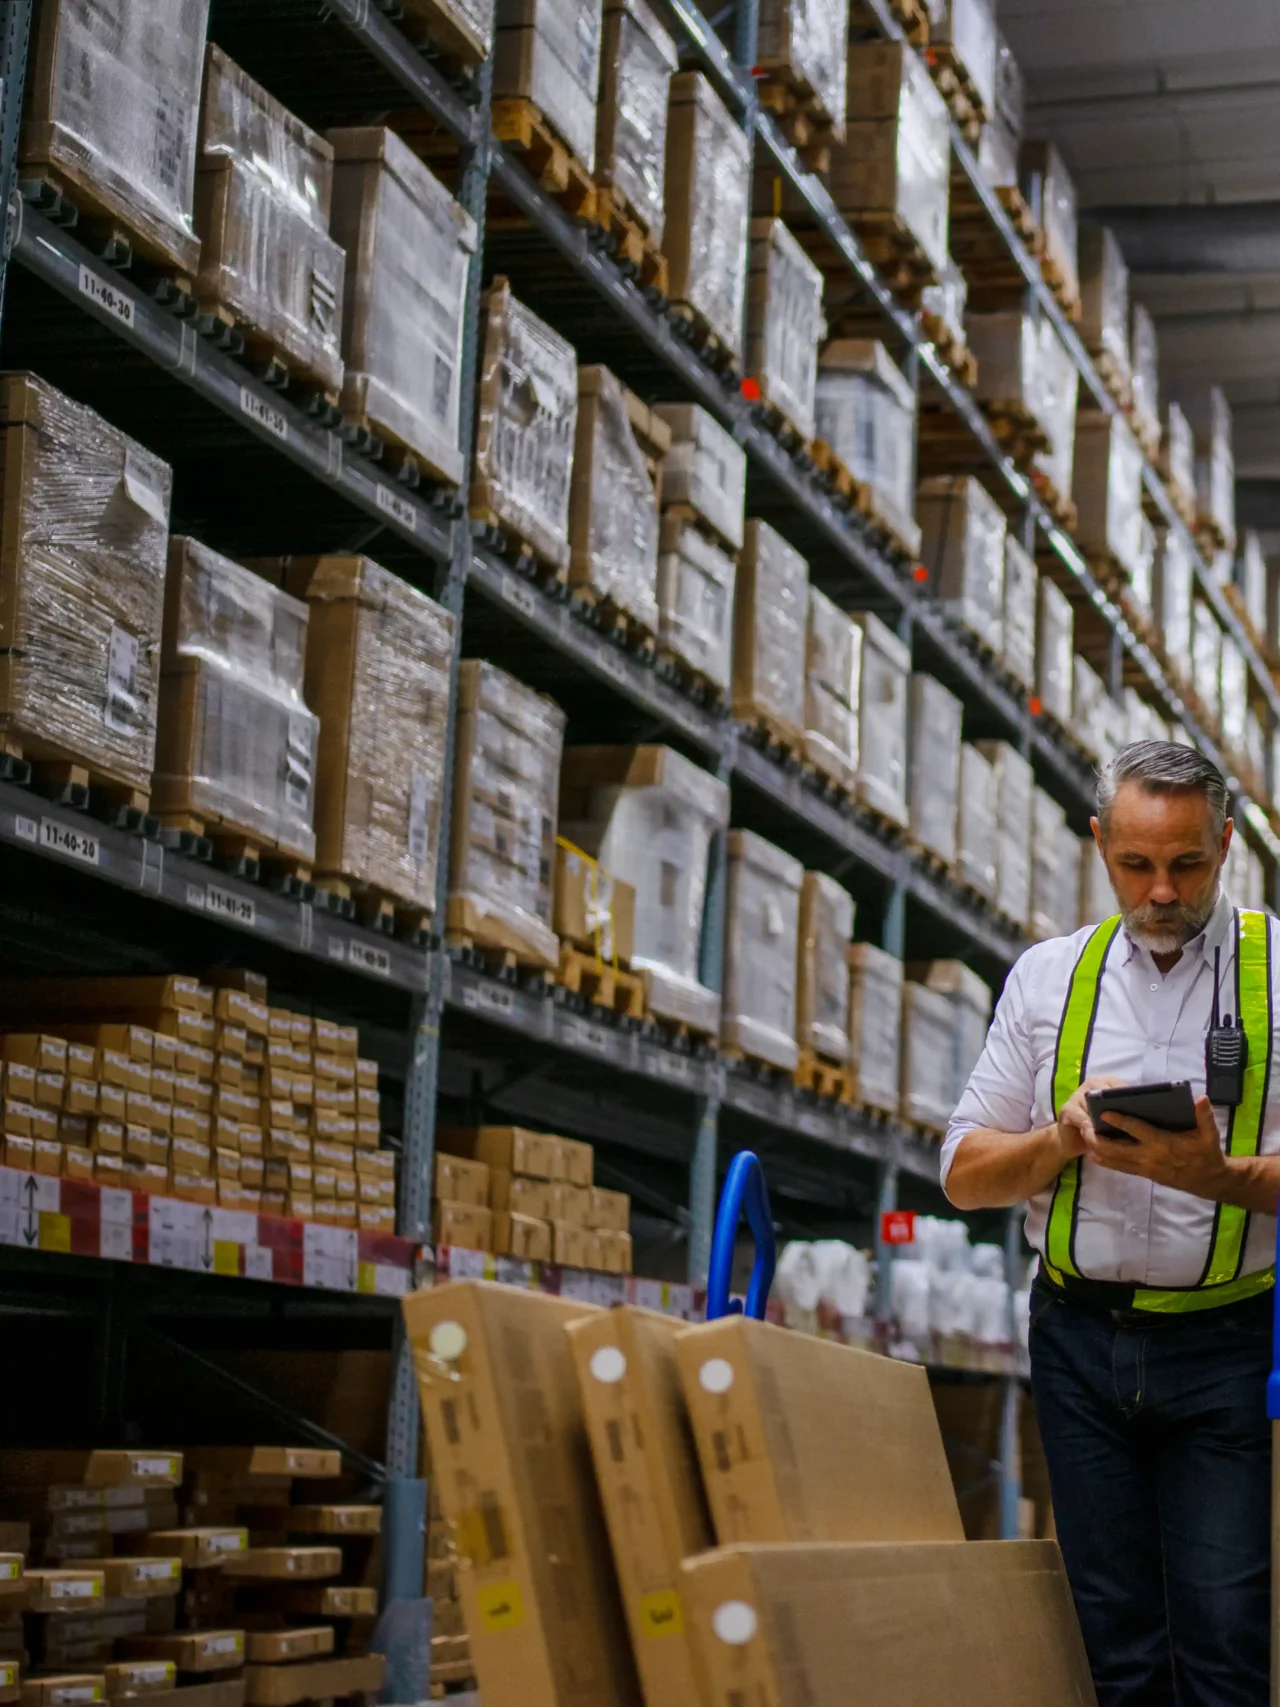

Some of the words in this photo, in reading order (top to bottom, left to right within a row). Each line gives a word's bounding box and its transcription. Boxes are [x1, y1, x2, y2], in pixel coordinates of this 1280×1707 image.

[84, 273, 131, 321] 11-40-30
[46, 824, 95, 859] 11-40-20
[211, 891, 251, 921] 11-41-20
